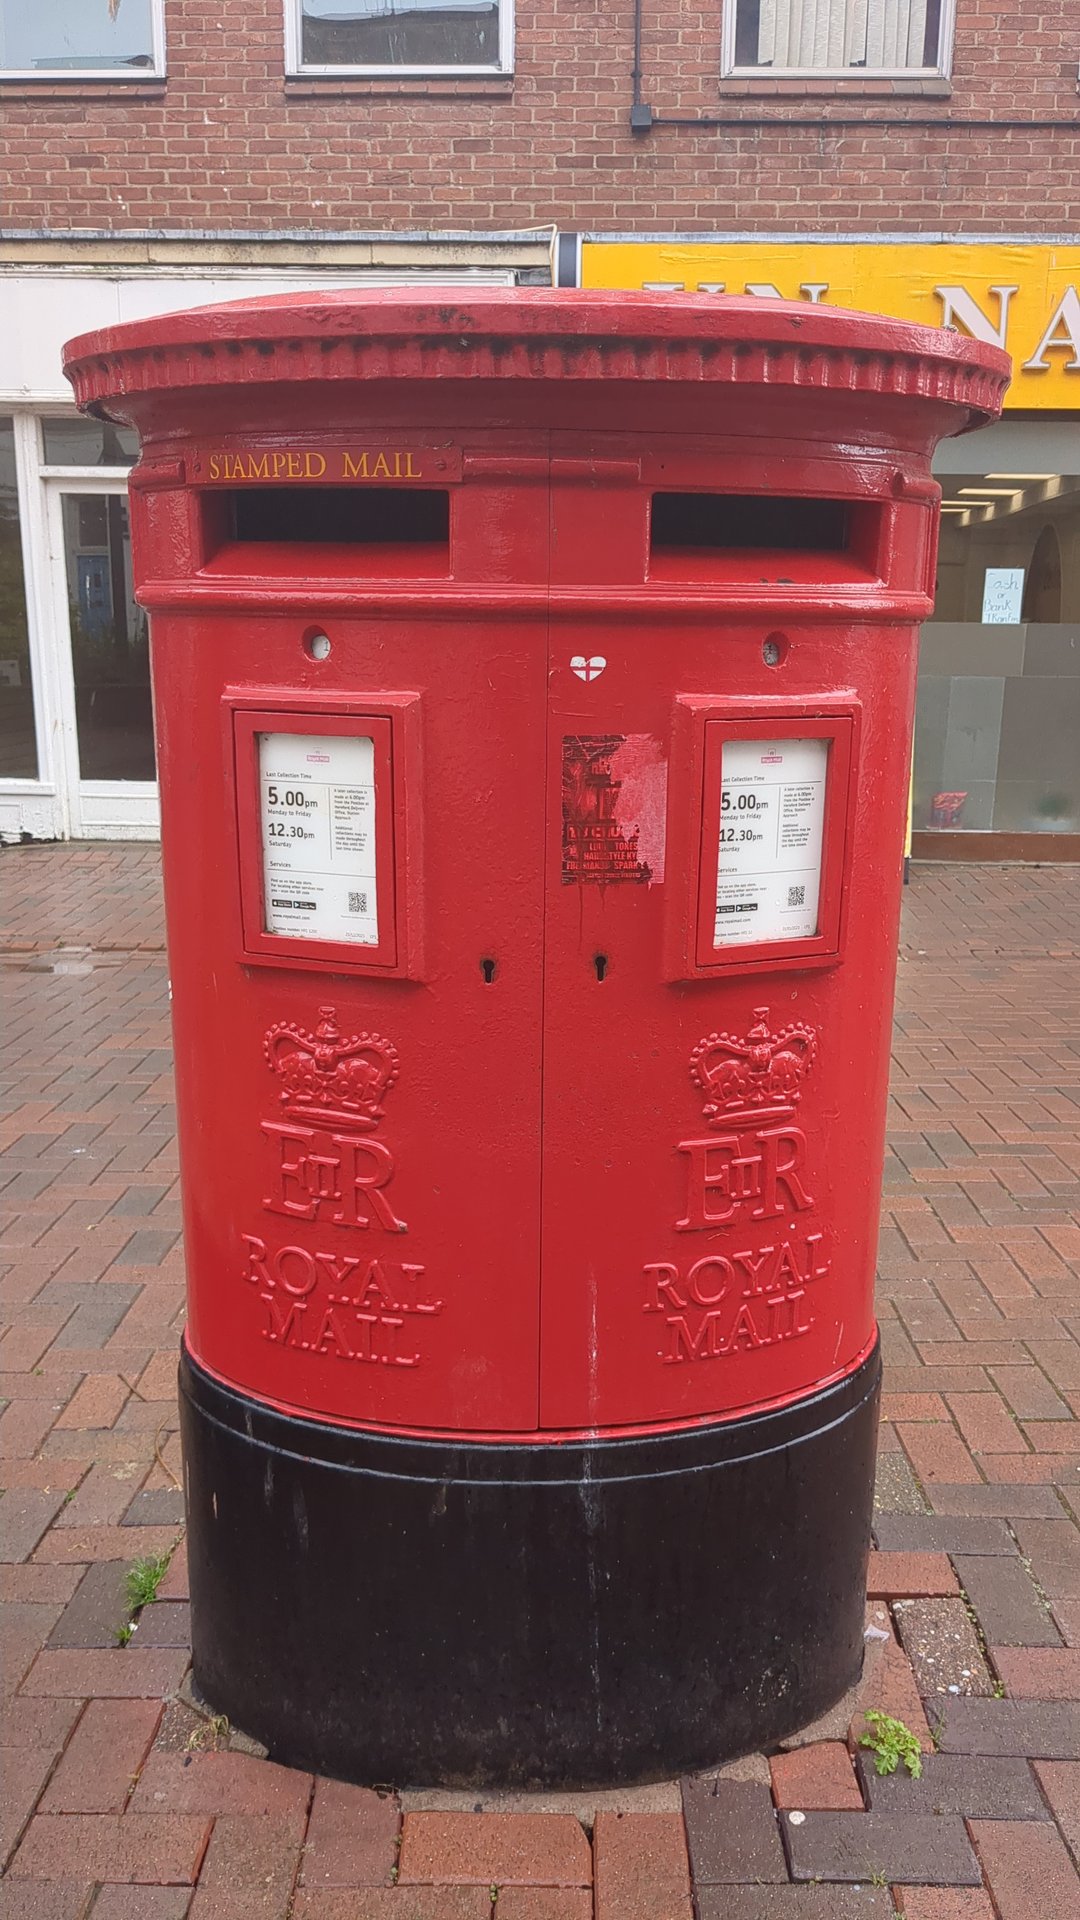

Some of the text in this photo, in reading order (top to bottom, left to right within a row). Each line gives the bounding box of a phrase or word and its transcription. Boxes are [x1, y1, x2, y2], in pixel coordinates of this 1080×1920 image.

[210, 452, 422, 480] STAMPED MAIL
[268, 786, 318, 809] 5.00pm
[721, 791, 769, 811] 5.00pm
[268, 809, 288, 817] Monday
[295, 810, 312, 818] Friday
[268, 822, 315, 839] 12.30pm
[719, 828, 763, 842] 12.30pm
[269, 840, 292, 848] Saturday
[241, 1232, 446, 1316] ROYAL
[642, 1232, 833, 1313] ROYAL
[260, 1292, 420, 1368] MAIL
[662, 1289, 816, 1365] MAIL
